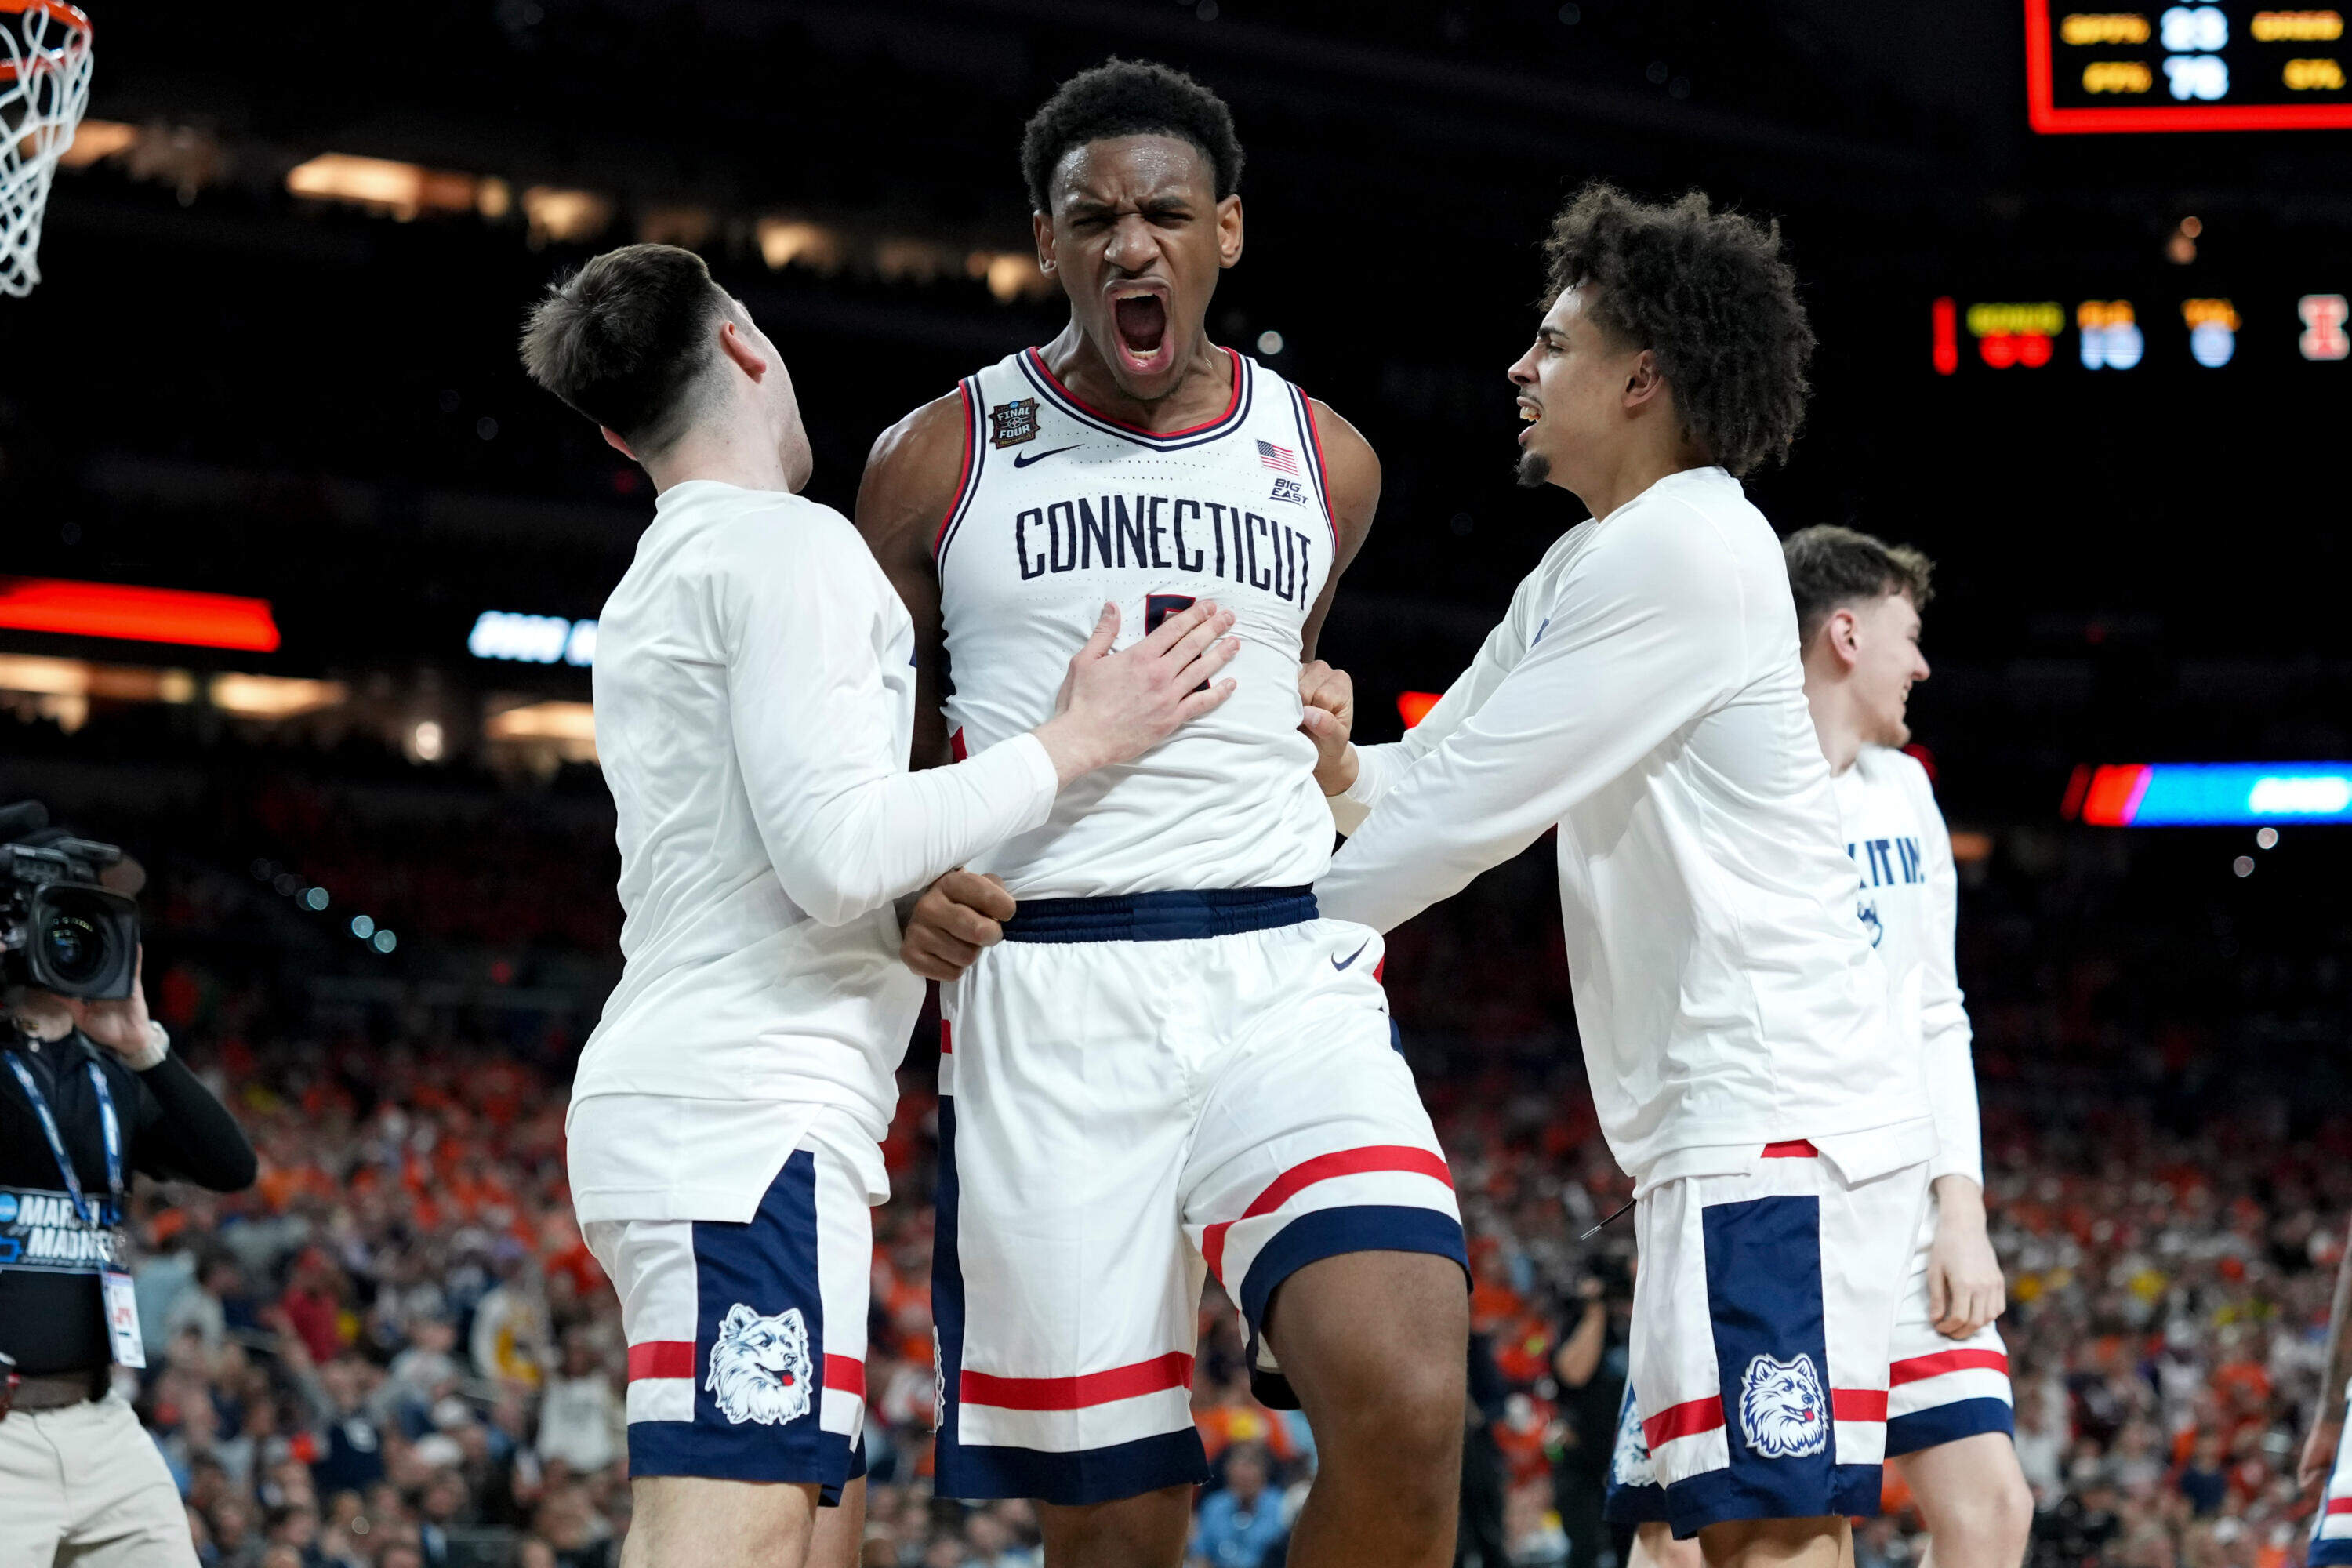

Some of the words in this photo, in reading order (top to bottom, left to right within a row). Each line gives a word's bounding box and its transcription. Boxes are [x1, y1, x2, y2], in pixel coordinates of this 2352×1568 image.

[997, 407, 1030, 421] FINAL
[999, 424, 1031, 439] FOUR
[1274, 478, 1301, 492] BIG
[1271, 487, 1309, 504] EAST
[1016, 495, 1311, 611] CONNECTICUT
[16, 1194, 100, 1229] MARH
